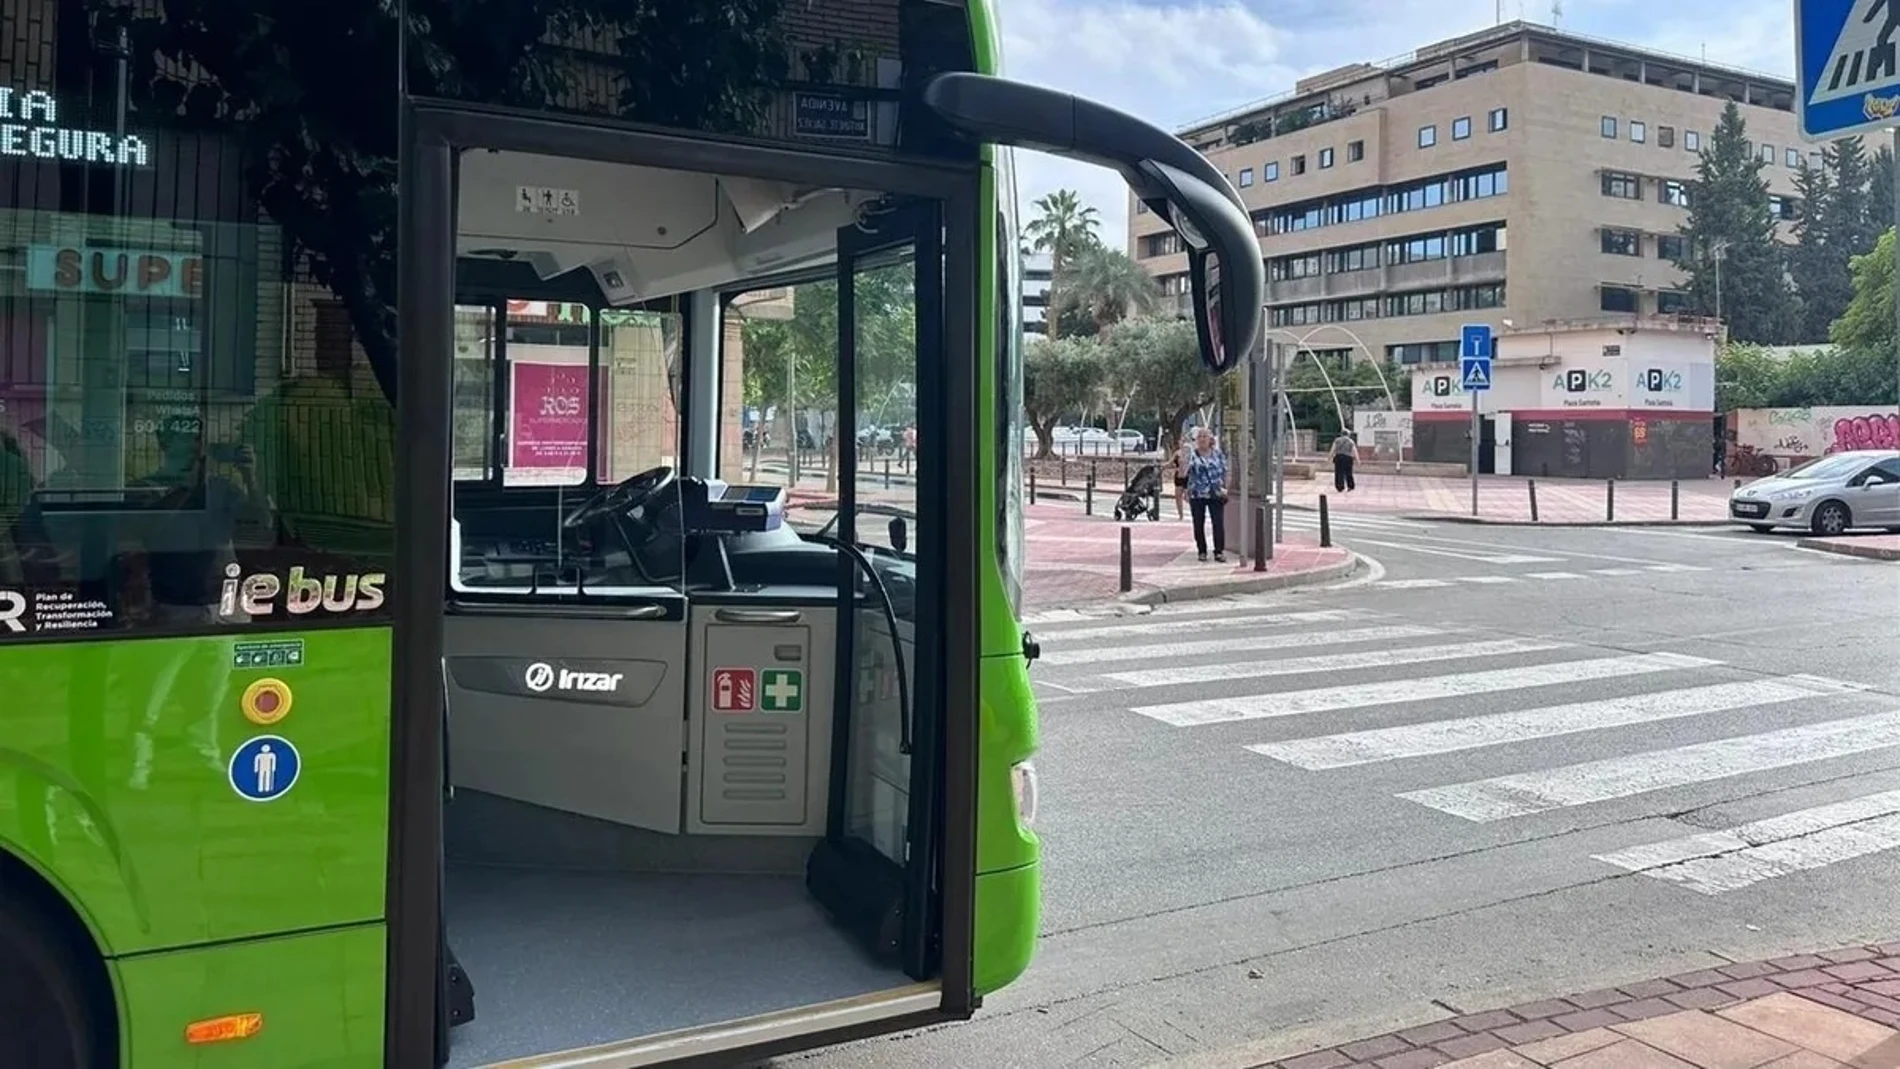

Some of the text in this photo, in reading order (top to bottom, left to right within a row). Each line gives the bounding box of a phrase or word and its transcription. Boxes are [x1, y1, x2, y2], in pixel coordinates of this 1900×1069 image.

[1, 124, 147, 165] EGURA
[134, 419, 200, 433] 604 422
[60, 592, 73, 600] de
[36, 600, 107, 610] Recuperación,
[35, 609, 113, 620] Transformación
[36, 619, 98, 631] y Resiliencia
[559, 668, 623, 691] Irizar
